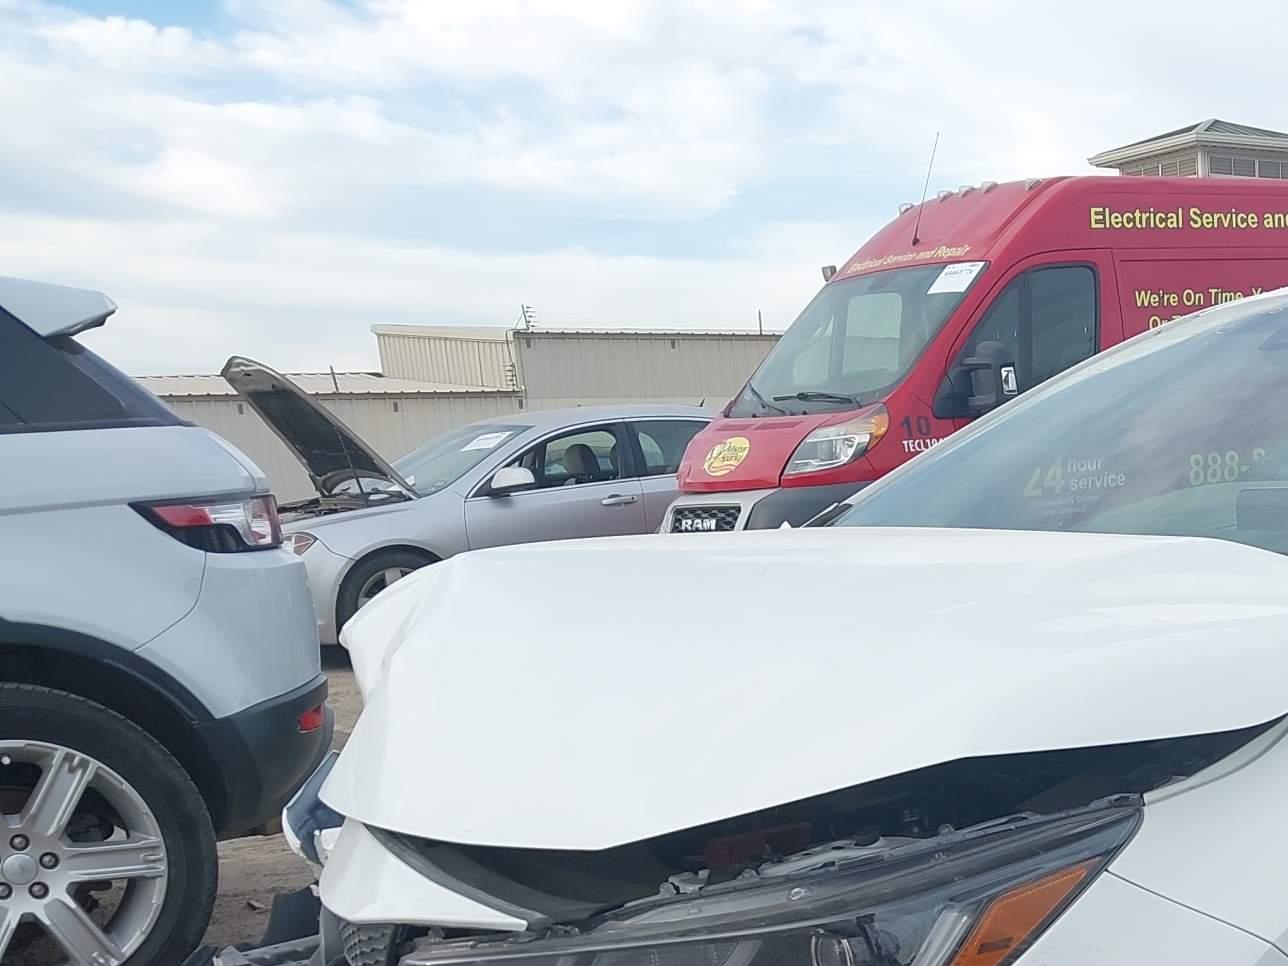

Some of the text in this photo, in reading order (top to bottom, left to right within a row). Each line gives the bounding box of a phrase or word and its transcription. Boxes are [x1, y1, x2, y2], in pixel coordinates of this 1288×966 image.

[1090, 207, 1183, 229] Electrical
[1189, 207, 1258, 229] Service
[936, 244, 970, 260] Repair
[1134, 289, 1179, 307] We're
[1182, 289, 1204, 306] On
[900, 415, 931, 438] 10
[1066, 456, 1105, 473] hour
[1069, 471, 1126, 491] service
[681, 518, 717, 531] RAM
